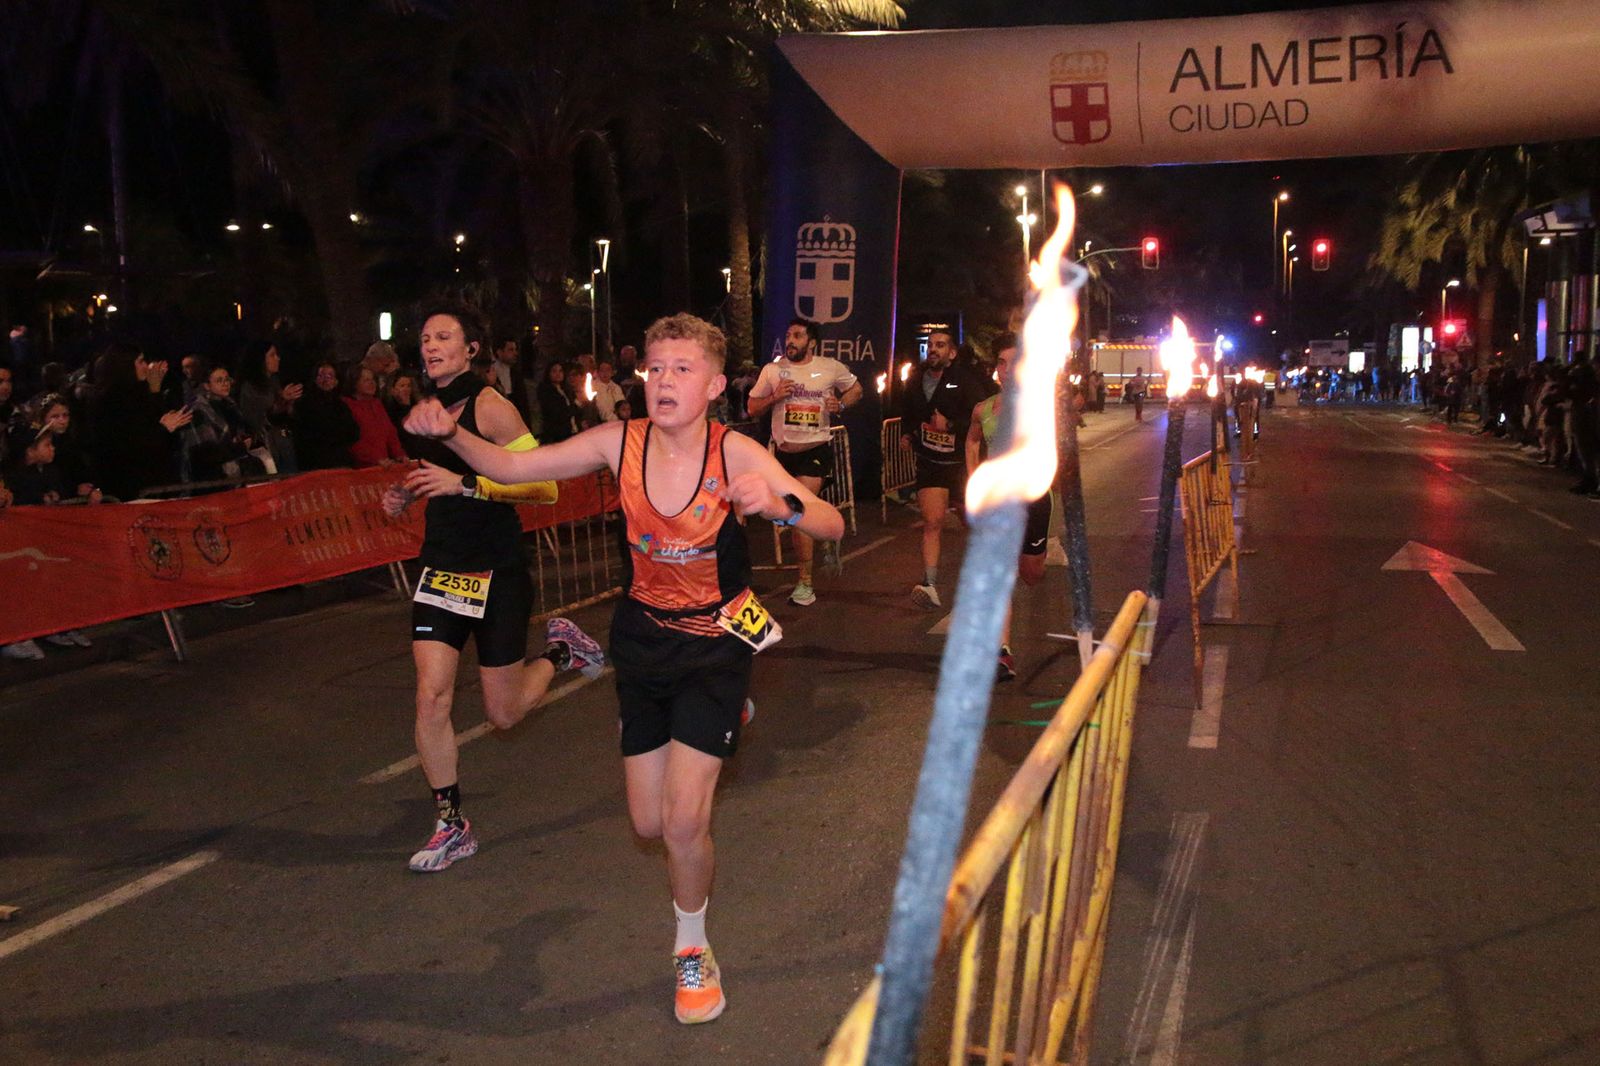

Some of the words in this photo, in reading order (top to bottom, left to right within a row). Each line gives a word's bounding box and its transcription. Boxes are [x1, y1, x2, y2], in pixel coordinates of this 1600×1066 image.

[1169, 23, 1455, 93] ALMERÍA
[1169, 98, 1309, 133] CIUDAD
[771, 334, 876, 361] AERÍA
[792, 412, 816, 421] 2213
[928, 432, 950, 442] 2212
[438, 573, 481, 593] 2530
